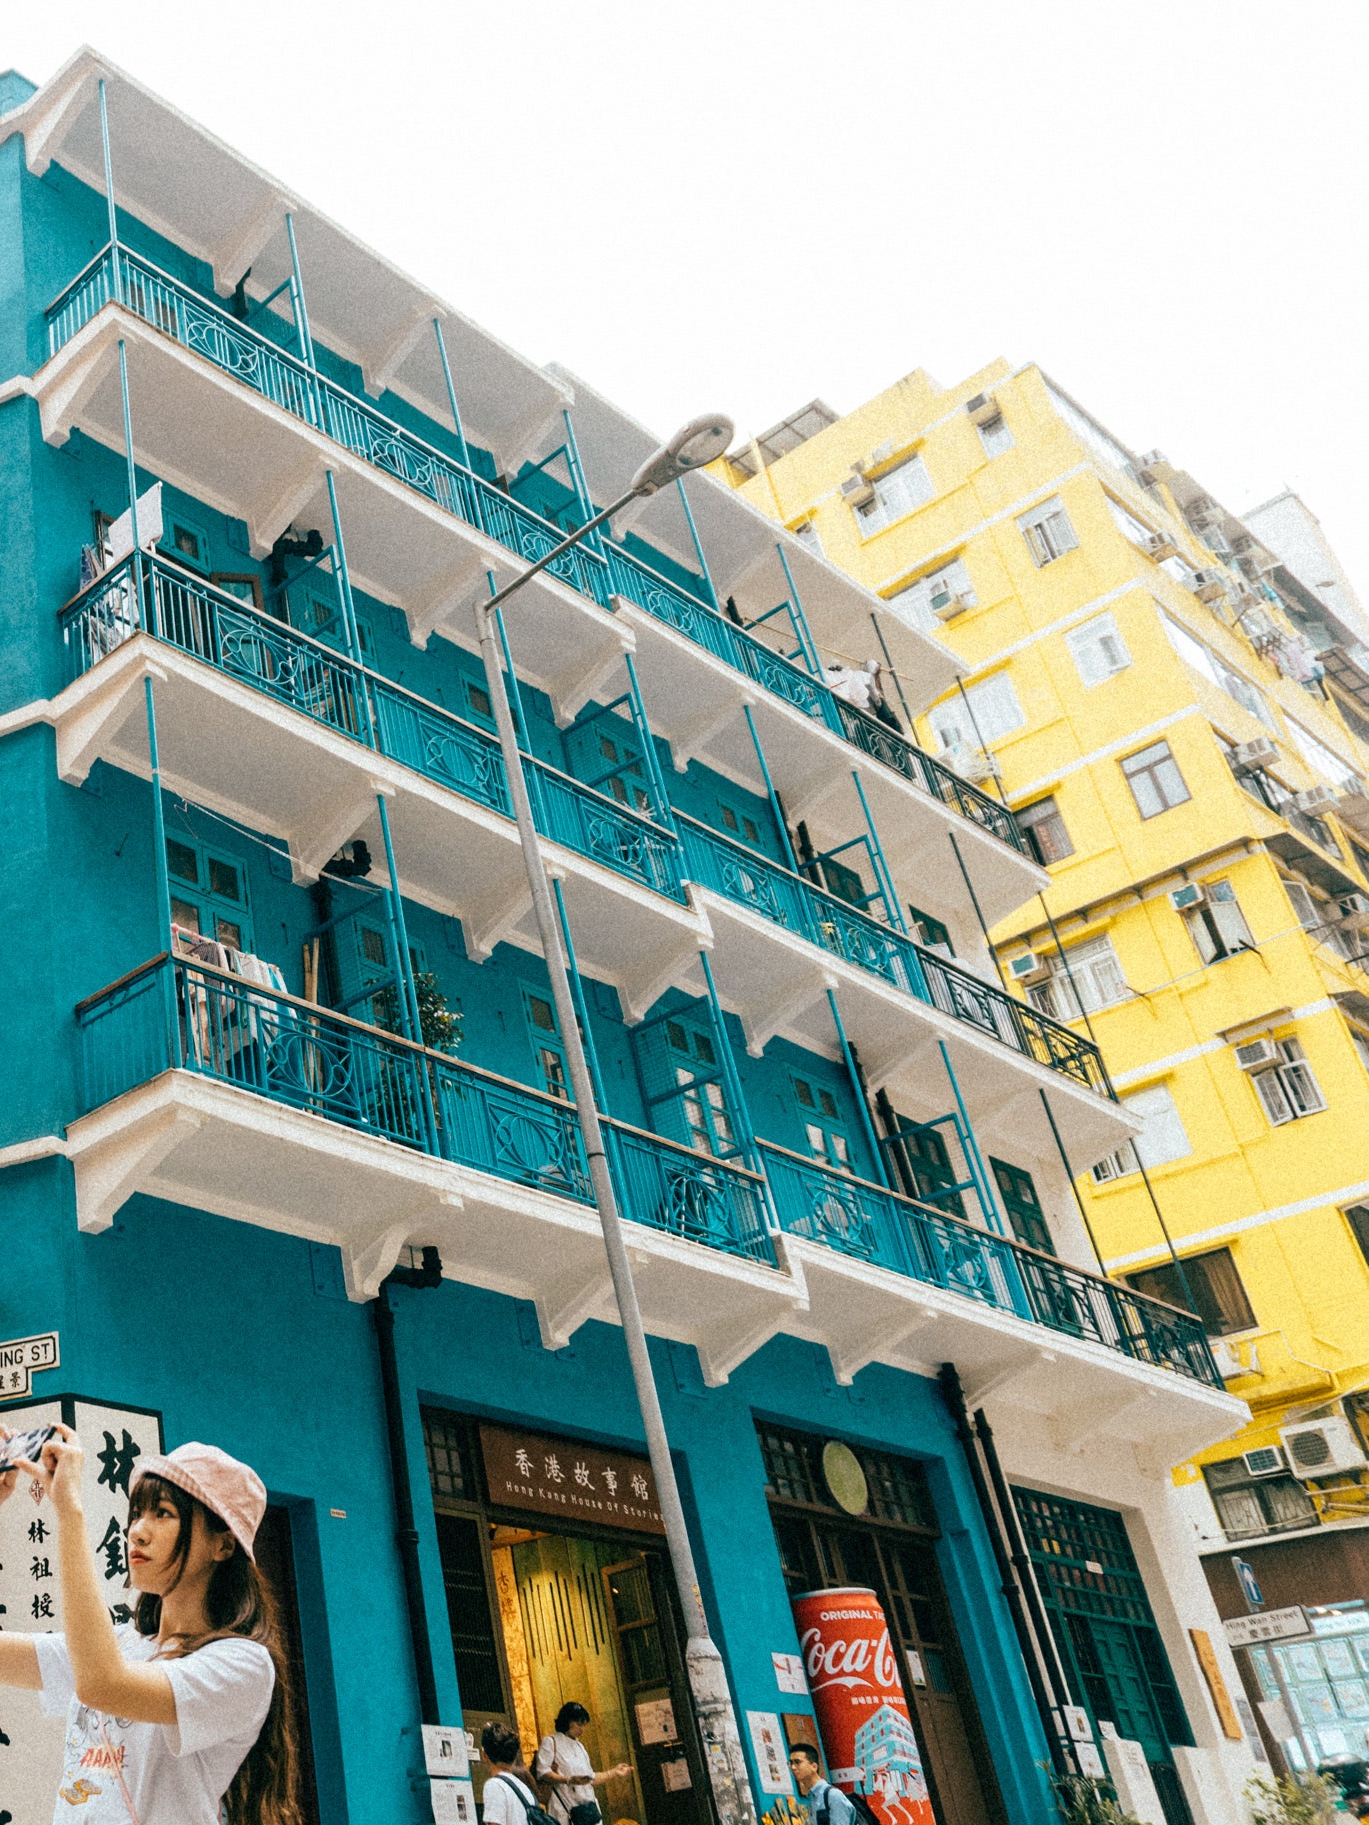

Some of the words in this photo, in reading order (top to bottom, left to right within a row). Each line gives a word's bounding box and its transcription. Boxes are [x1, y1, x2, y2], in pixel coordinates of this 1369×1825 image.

[31, 1343, 50, 1361] ST
[515, 1449, 649, 1501] 香港故事館
[506, 1481, 534, 1497] Hong
[539, 1488, 566, 1504] Kong
[571, 1494, 603, 1511] House
[607, 1502, 619, 1513] Of
[623, 1504, 664, 1521] Stories
[28, 1518, 56, 1634] 林祖授
[820, 1609, 873, 1622] ORIGINAL
[1225, 1620, 1246, 1631] Hing
[1248, 1616, 1268, 1626] Wan
[1269, 1609, 1299, 1621] Street
